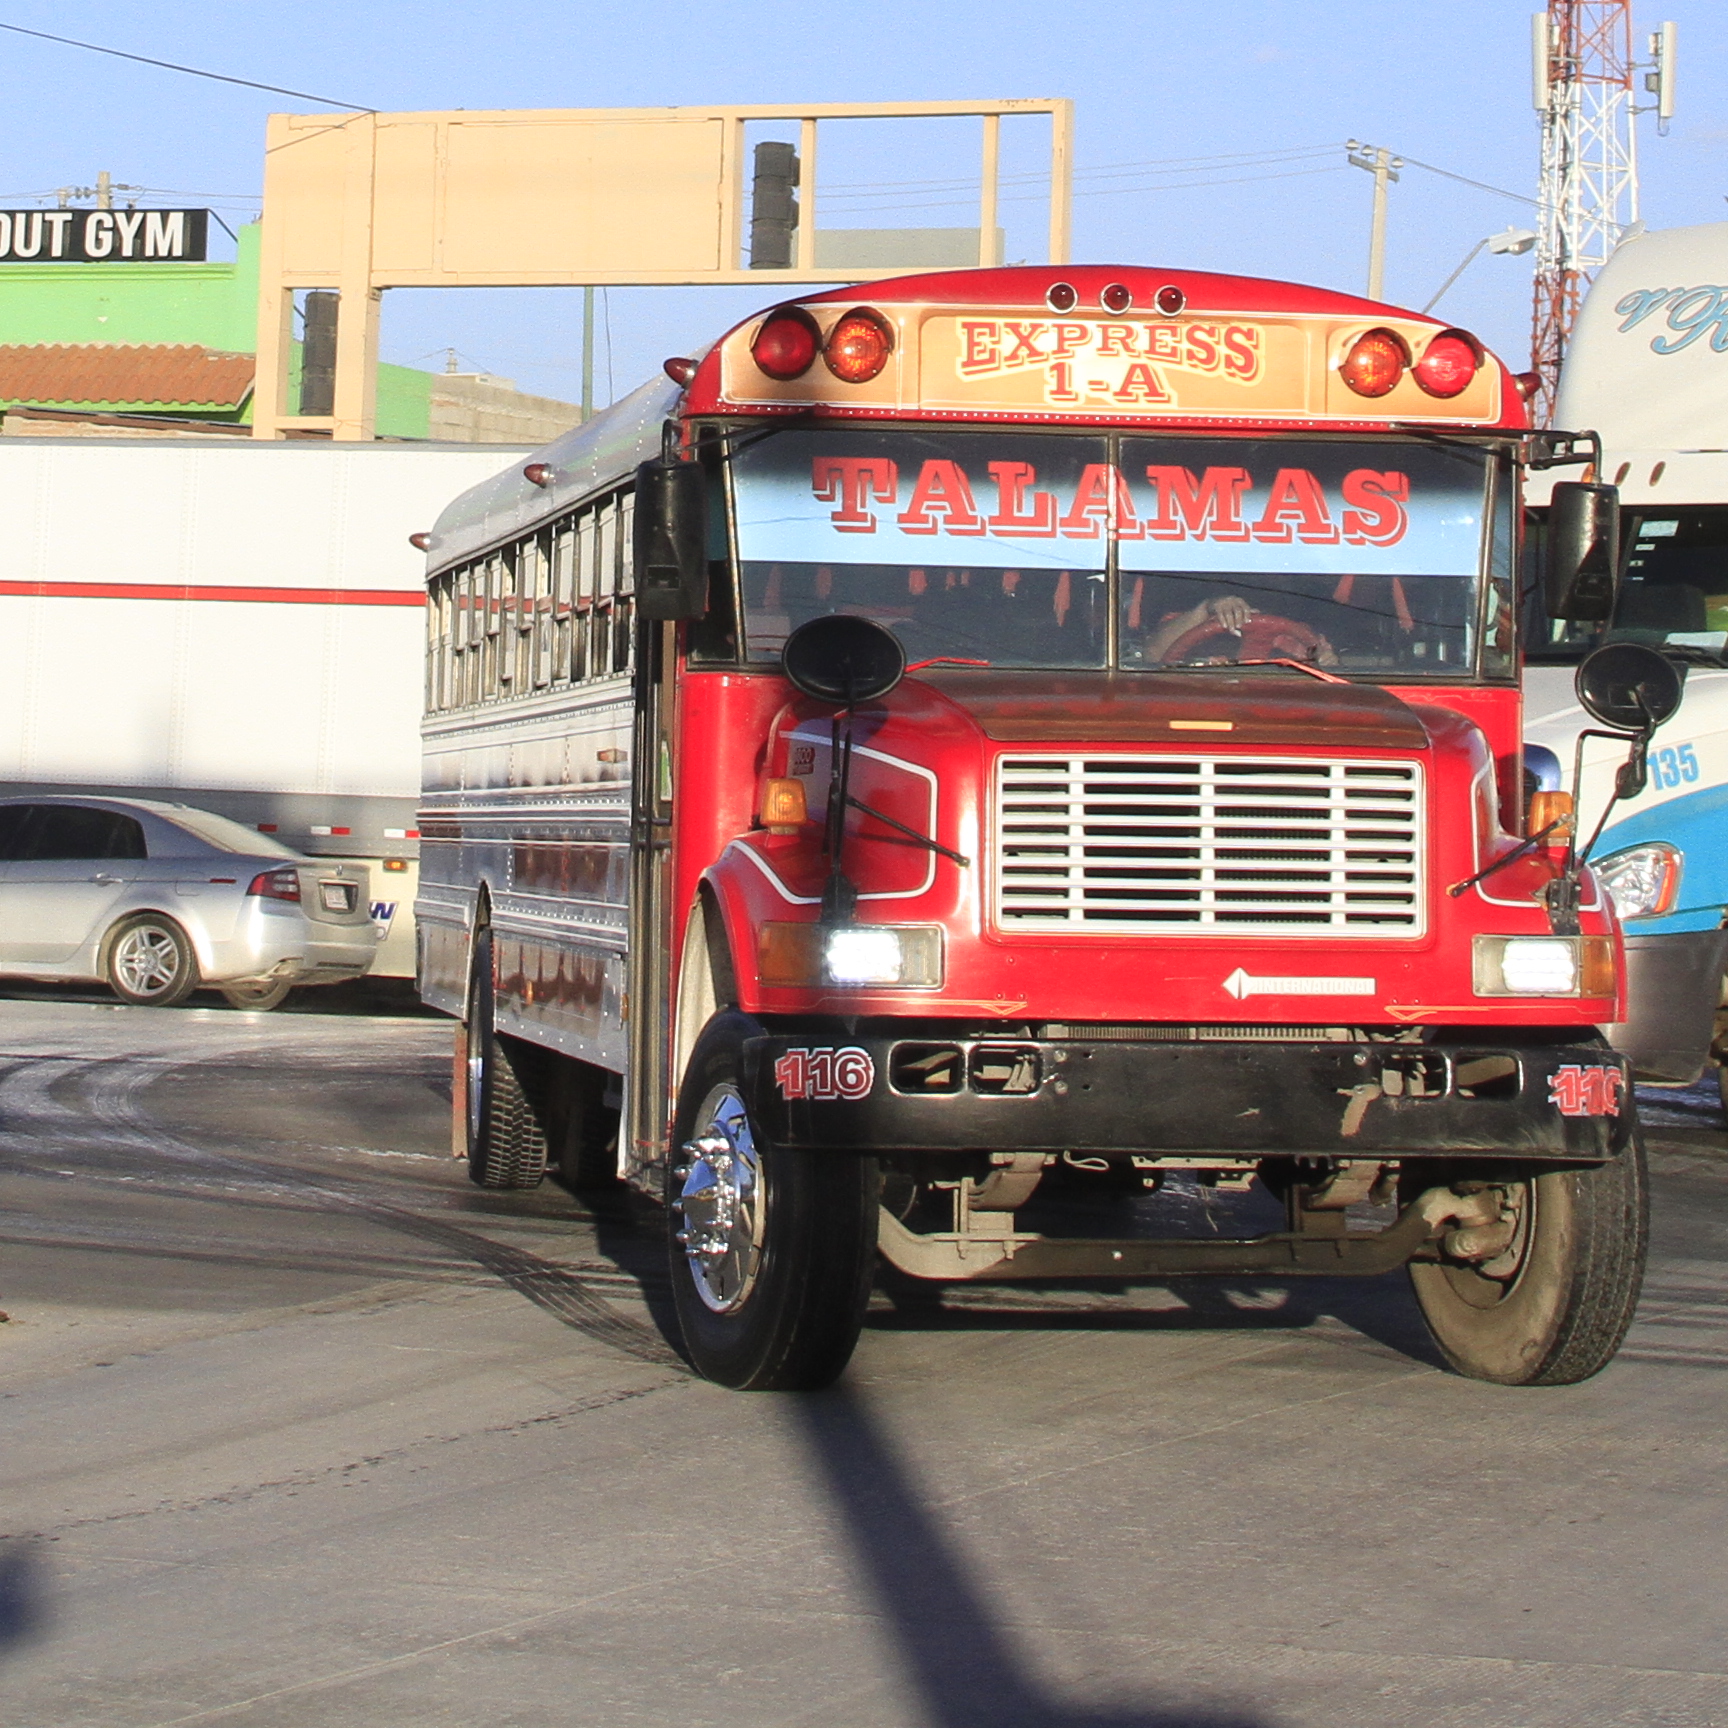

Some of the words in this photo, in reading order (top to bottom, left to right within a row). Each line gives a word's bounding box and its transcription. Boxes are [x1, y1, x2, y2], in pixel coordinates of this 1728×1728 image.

[84, 211, 184, 258] GYM
[959, 317, 1264, 382] EXPRESS
[1042, 360, 1172, 404] 1-A
[813, 456, 1410, 548] TALAMAS
[1646, 743, 1700, 791] 135
[1257, 978, 1373, 994] INTERNATIONAL
[775, 1046, 875, 1101] 116
